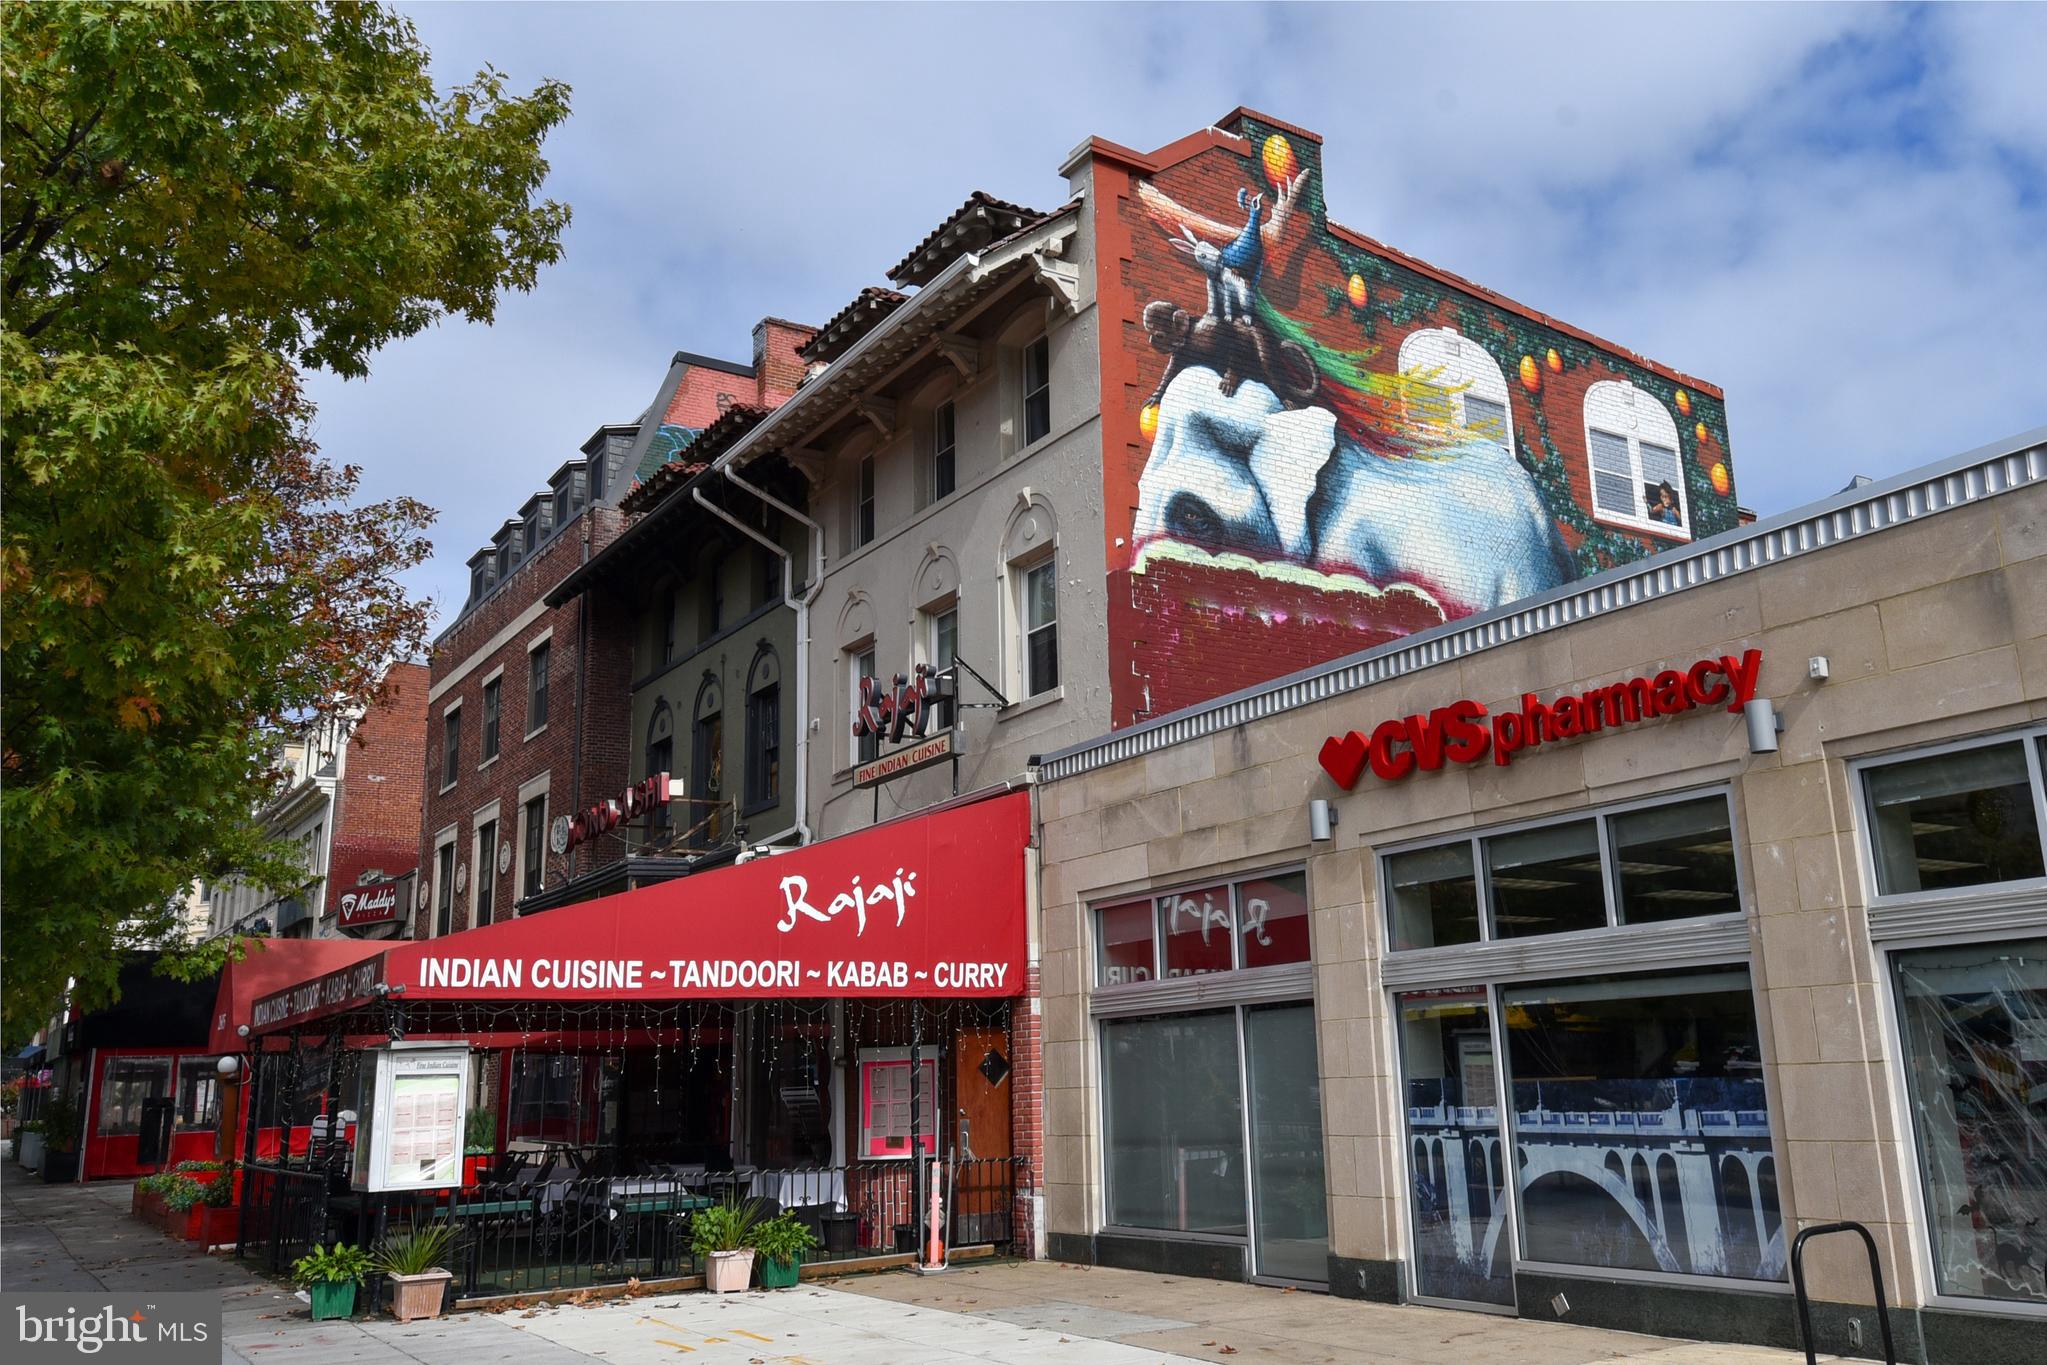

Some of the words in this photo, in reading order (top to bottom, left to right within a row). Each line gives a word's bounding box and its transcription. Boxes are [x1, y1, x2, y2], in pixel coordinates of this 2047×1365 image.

[1369, 699, 1491, 781] CVS
[1492, 648, 1762, 766] pharmacy
[860, 767, 876, 783] FINE
[878, 754, 909, 776] INDIAN
[912, 740, 946, 763] CUISINE
[356, 888, 396, 915] Maddy's
[777, 867, 917, 937] Rajaji
[419, 957, 522, 988] INDIAN
[531, 958, 643, 989] CUISINE
[669, 960, 800, 989] TANDOORI
[827, 961, 908, 988] KABAB
[934, 962, 1008, 988] CURRY
